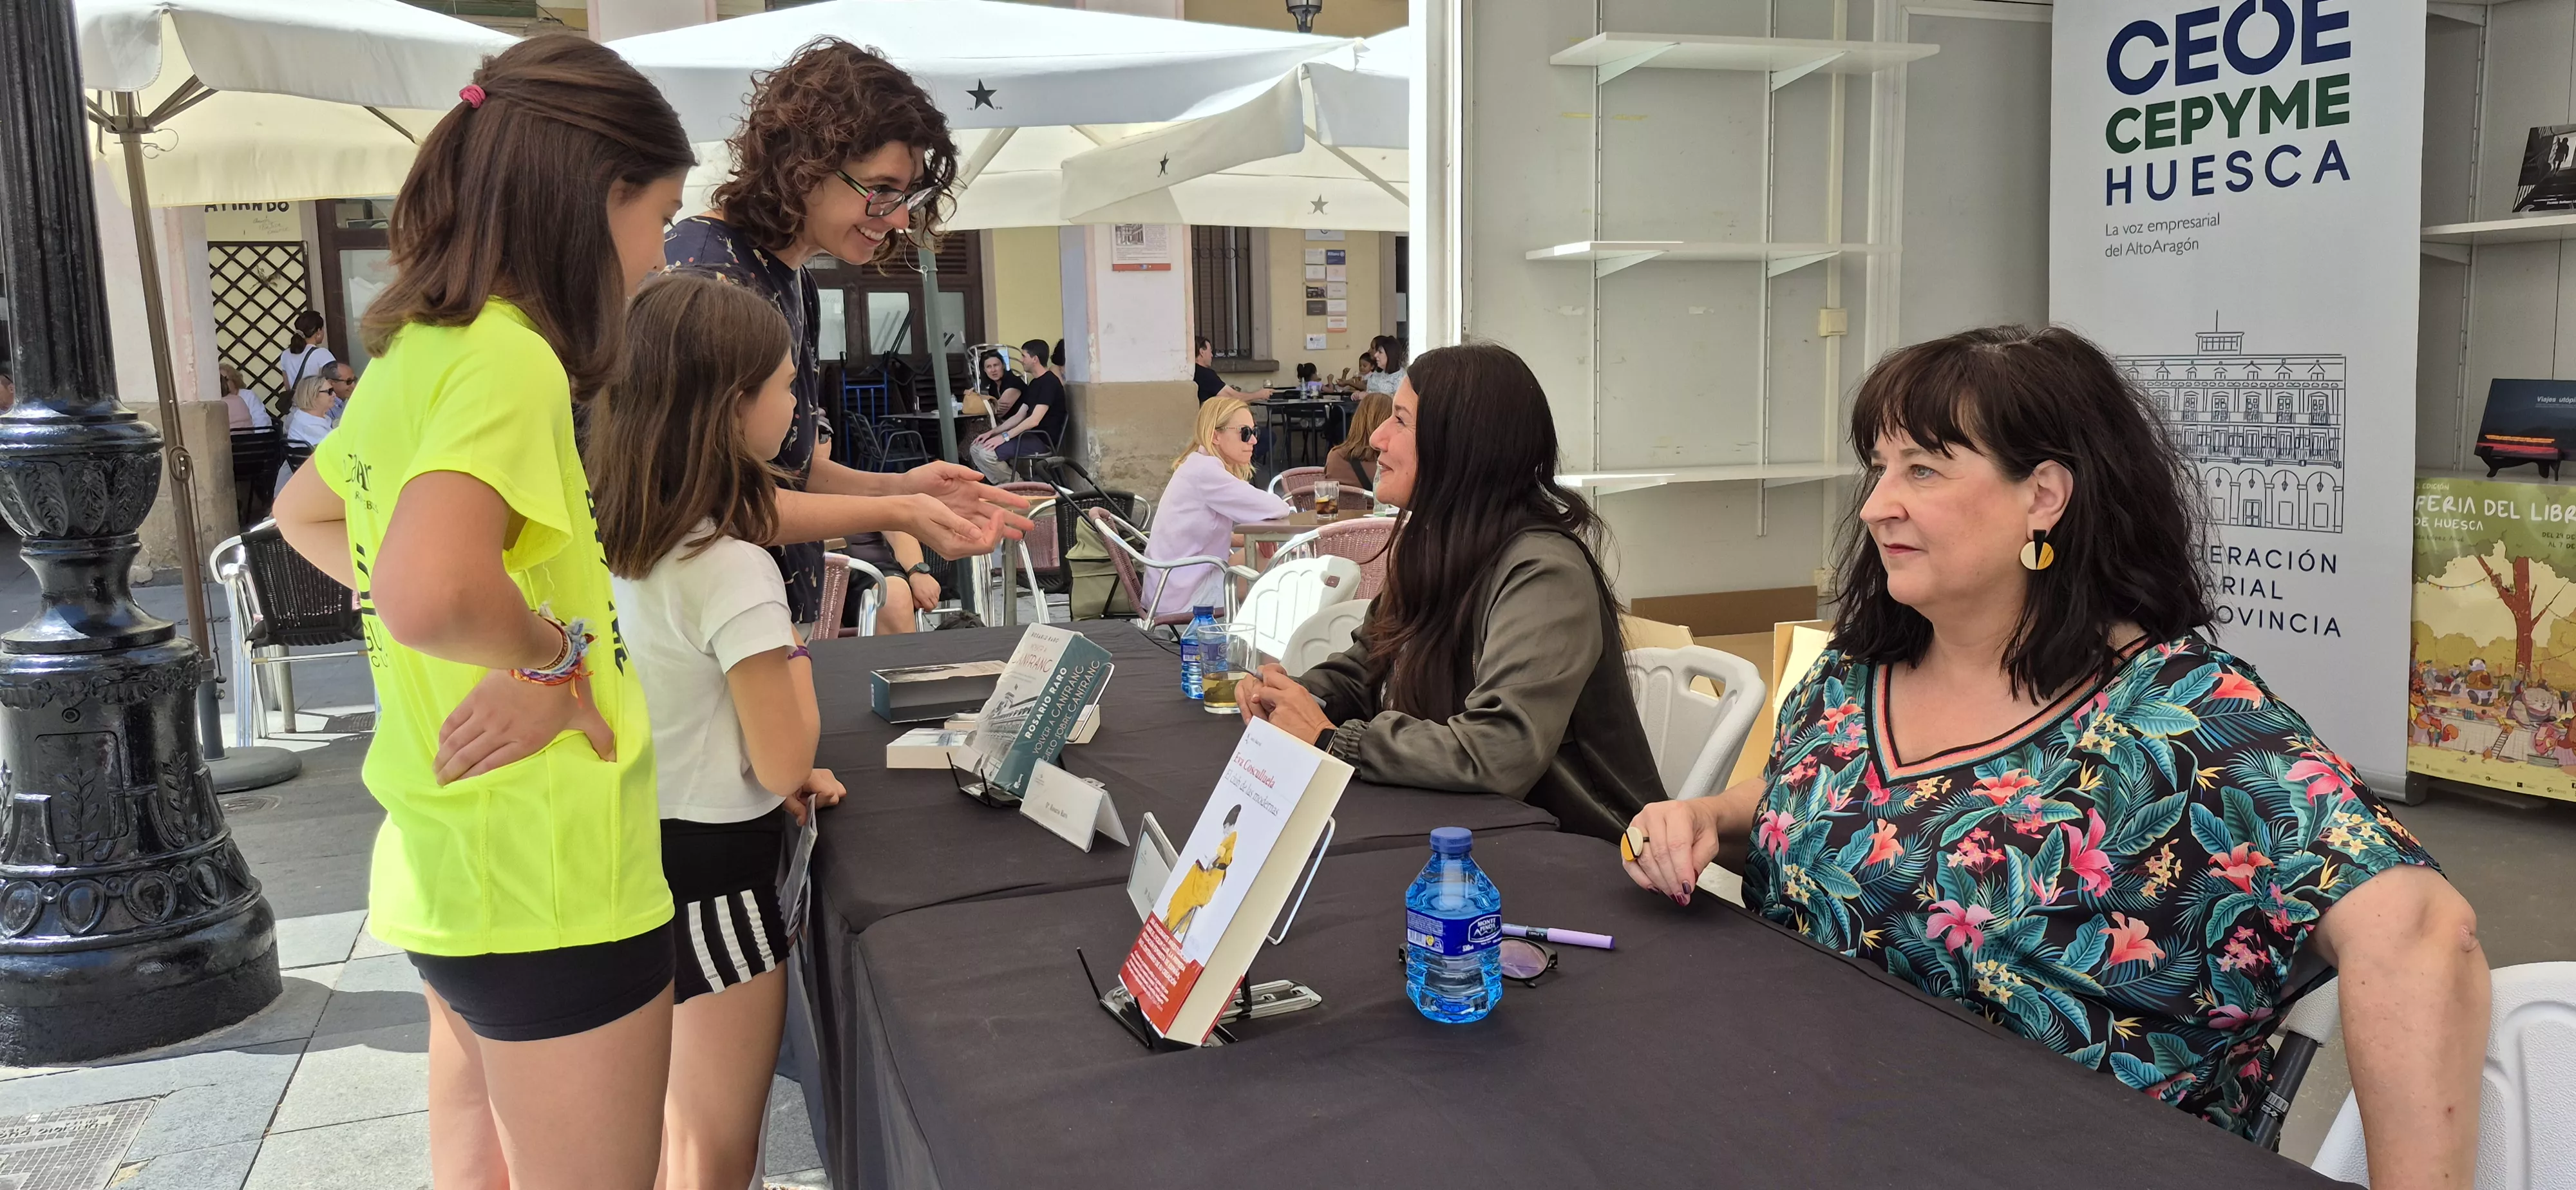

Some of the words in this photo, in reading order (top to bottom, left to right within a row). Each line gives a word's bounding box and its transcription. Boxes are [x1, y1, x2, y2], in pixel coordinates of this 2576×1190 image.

[2107, 0, 2351, 95] CEOE
[2106, 73, 2349, 154] CEPYME
[2107, 139, 2351, 206] HUESCA
[2105, 243, 2123, 258] del
[2125, 237, 2199, 256] AltoAragón
[2106, 223, 2119, 236] La
[2123, 222, 2143, 235] voz
[2147, 212, 2220, 234] empresarial
[2414, 517, 2429, 527] DE
[2434, 518, 2483, 531] HUESCA
[2415, 495, 2476, 515] FERIA
[2484, 499, 2521, 519] DEL
[1024, 695, 1052, 739] ROSARIO
[1049, 667, 1068, 695] RARO
[1032, 726, 1052, 755] VOLVER
[1051, 665, 1084, 718] CANFRANC
[1054, 713, 1072, 739] SOBRE
[1068, 660, 1101, 713] CANFRANC
[1233, 751, 1245, 766] Eva
[1244, 759, 1275, 789] Cosculluela
[1239, 780, 1247, 792] de
[1253, 793, 1280, 817] modernas
